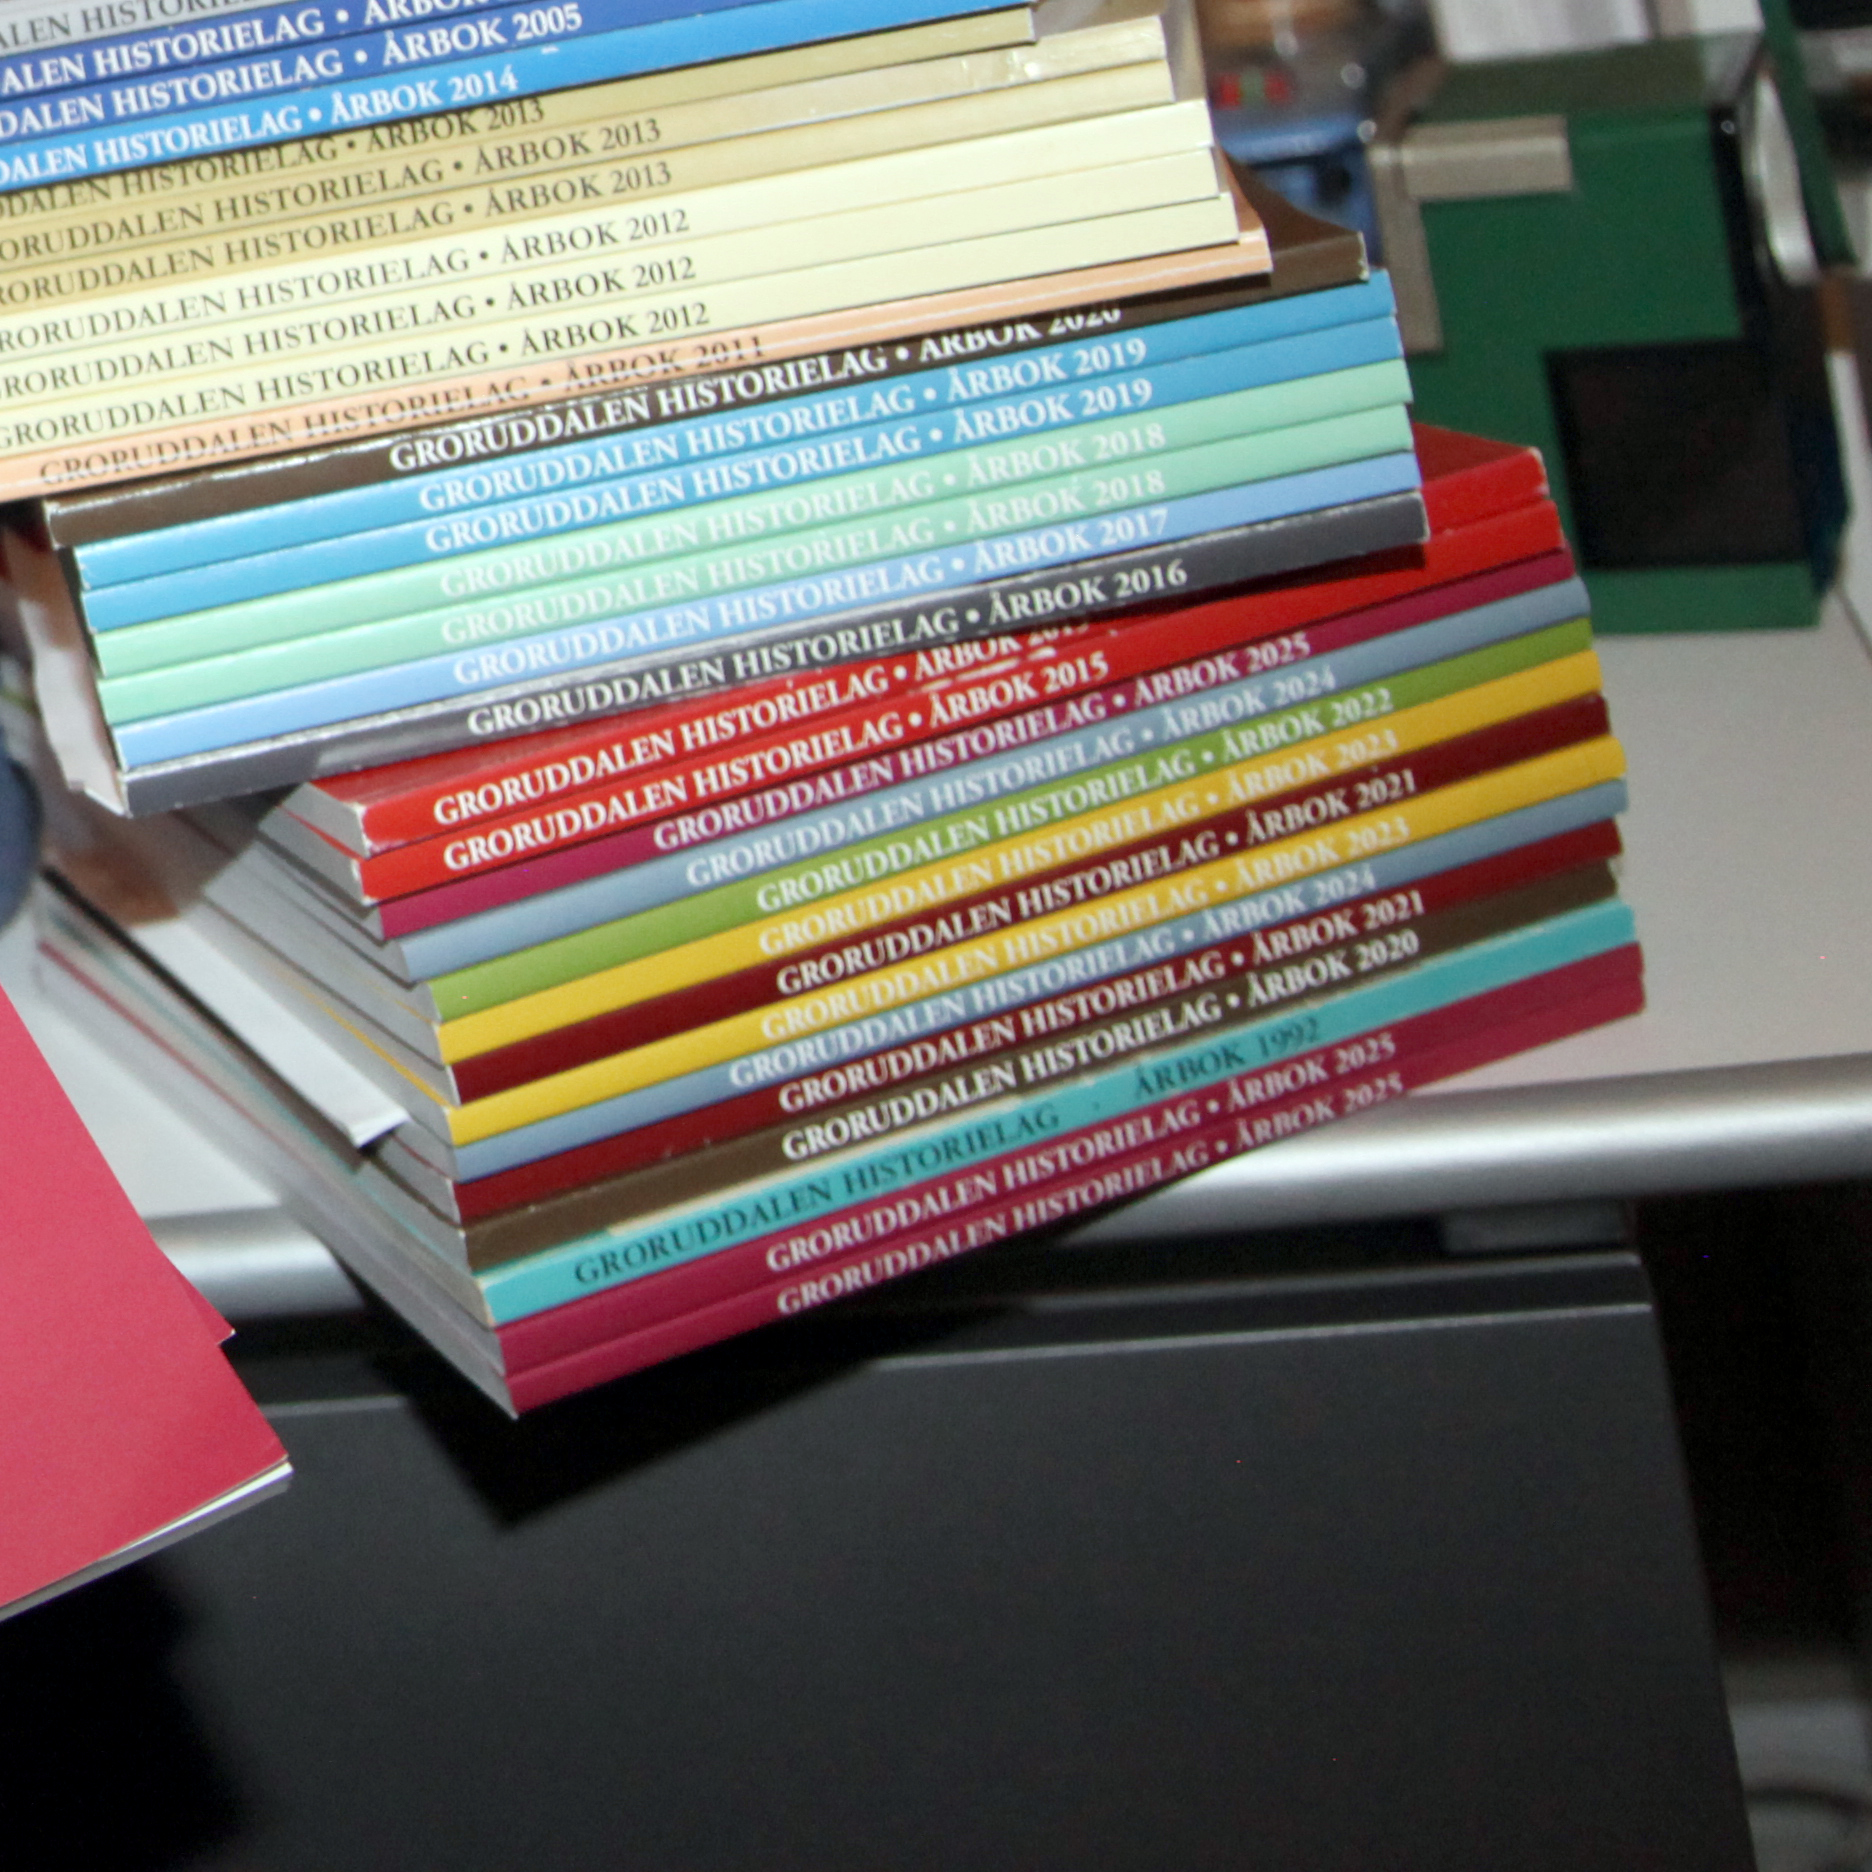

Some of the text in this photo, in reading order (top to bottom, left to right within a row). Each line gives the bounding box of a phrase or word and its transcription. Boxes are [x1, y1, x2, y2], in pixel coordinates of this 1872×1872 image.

[93, 10, 325, 76] HISTORIELAG
[95, 107, 303, 167] HISTORIELAG
[326, 82, 442, 124] ÅRBOK
[448, 68, 518, 102] 2014
[111, 50, 343, 117] HISTORIELAG
[378, 19, 505, 66] ÅRBOK
[511, 4, 582, 40] 2005
[212, 158, 445, 223] HISTORIELAG
[469, 131, 591, 175] ÅRBOK
[597, 118, 661, 151] 2013
[224, 201, 455, 265] HISTORIELAG
[480, 175, 603, 219] ÅRBOK
[608, 162, 674, 196] 2013
[235, 247, 471, 311] HISTORIELAG
[496, 220, 619, 264] ÅRBOK
[626, 208, 690, 241] 2012
[244, 293, 477, 356] HISTORIELAG
[503, 267, 626, 311] ÅRBOK
[633, 255, 697, 288] 2012
[254, 339, 490, 404] HISTORIELAG
[515, 313, 638, 357] ÅRBOK
[645, 300, 710, 333] 2012
[389, 395, 650, 471] GRORUDDALEN
[656, 346, 889, 416] HISTORIELAG
[418, 339, 1148, 512] GRORUDDALEN HISTORIELAG ÅRBOK 2019
[425, 379, 1155, 553] GRORUDDALEN HISTORIELAG ÅRBOK 2019
[453, 510, 1172, 686] GRORUDDALEN HISTORIELAG ÅRBOK 2017
[466, 659, 726, 737] GRORUDDALEN
[732, 609, 960, 680] HISTORIELAG
[984, 578, 1106, 626] ÅRBOK
[1112, 561, 1188, 599] 2016
[431, 732, 677, 827] GRORUDDALEN
[680, 668, 890, 752] HISTORIELAG
[441, 651, 1109, 873] GRORUDDALEN HISTORIELAG ÅRBOK 2015
[652, 634, 1312, 851] GRORUDDALEN HISTORIELAG ÅRBOK 2025
[754, 688, 1394, 914] GRORUDDALEN HISTORIELAG ÅRBOK 2022
[775, 772, 1419, 996] GRORUDDALEN HISTORIELAG ÅRBOK 2021
[777, 891, 1426, 1114] GRORUDDALEN HISTORIELAG ÅRBOK 2021
[780, 930, 1422, 1163] GRORUDDALEN HISTORIELAG ÅRBOK 2020
[572, 1019, 1323, 1287] GRORUDDALEN HISTORIELAG ÅRBOK 1992
[1001, 1034, 1398, 1190] HISTORIELAG ÅRBOK 2025
